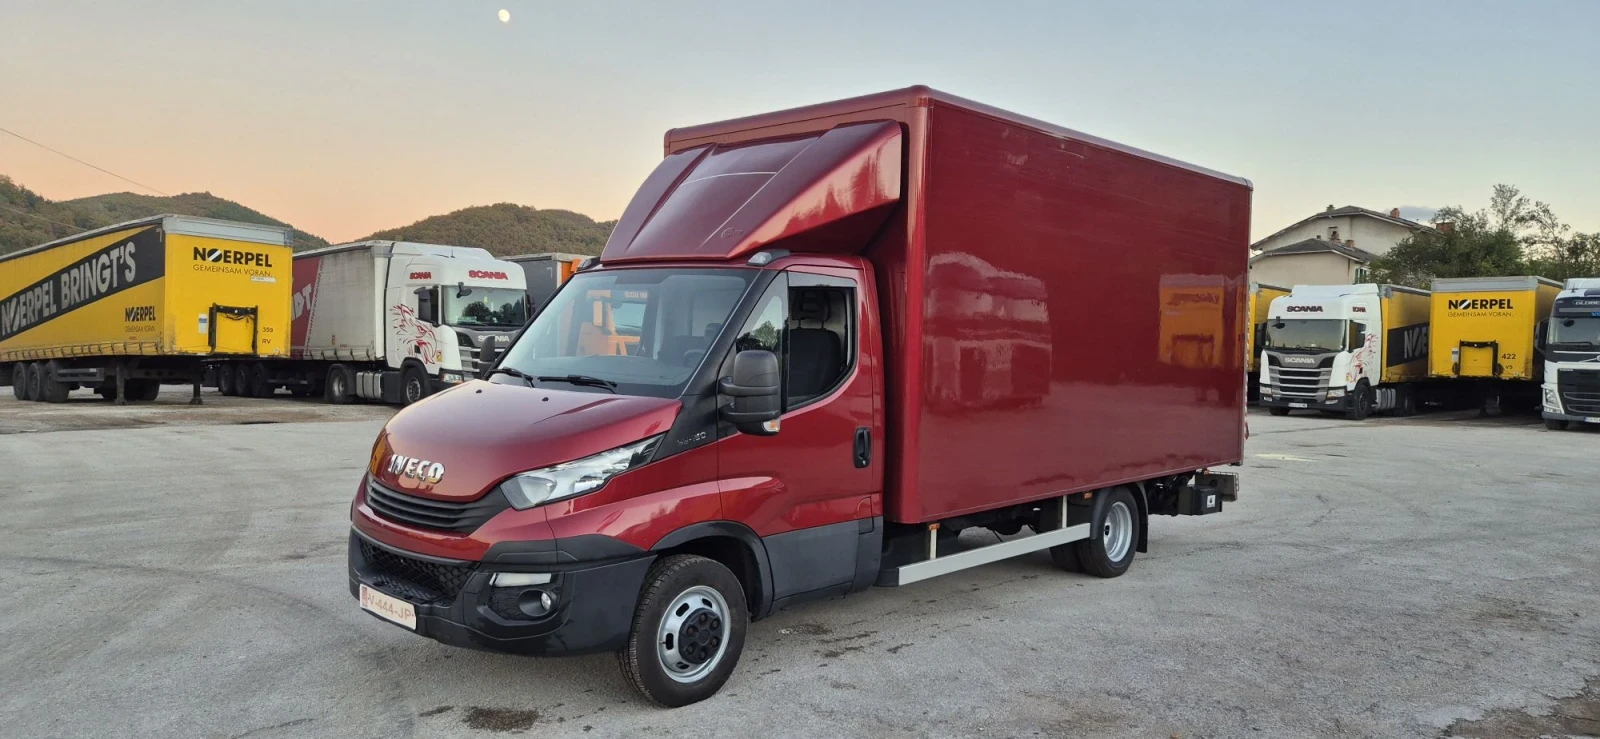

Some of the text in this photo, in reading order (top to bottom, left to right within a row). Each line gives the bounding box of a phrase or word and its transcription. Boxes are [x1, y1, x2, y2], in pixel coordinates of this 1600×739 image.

[193, 246, 273, 268] NOERPEL
[193, 264, 241, 275] GEMEINSAM
[468, 270, 508, 280] SCANIA
[0, 241, 136, 336] NOERPEL BRINGT'S
[1448, 298, 1513, 310] NOERPEL
[124, 305, 156, 322] NOERPEL
[1284, 356, 1315, 364] SCANIA
[388, 454, 445, 484] IVECO
